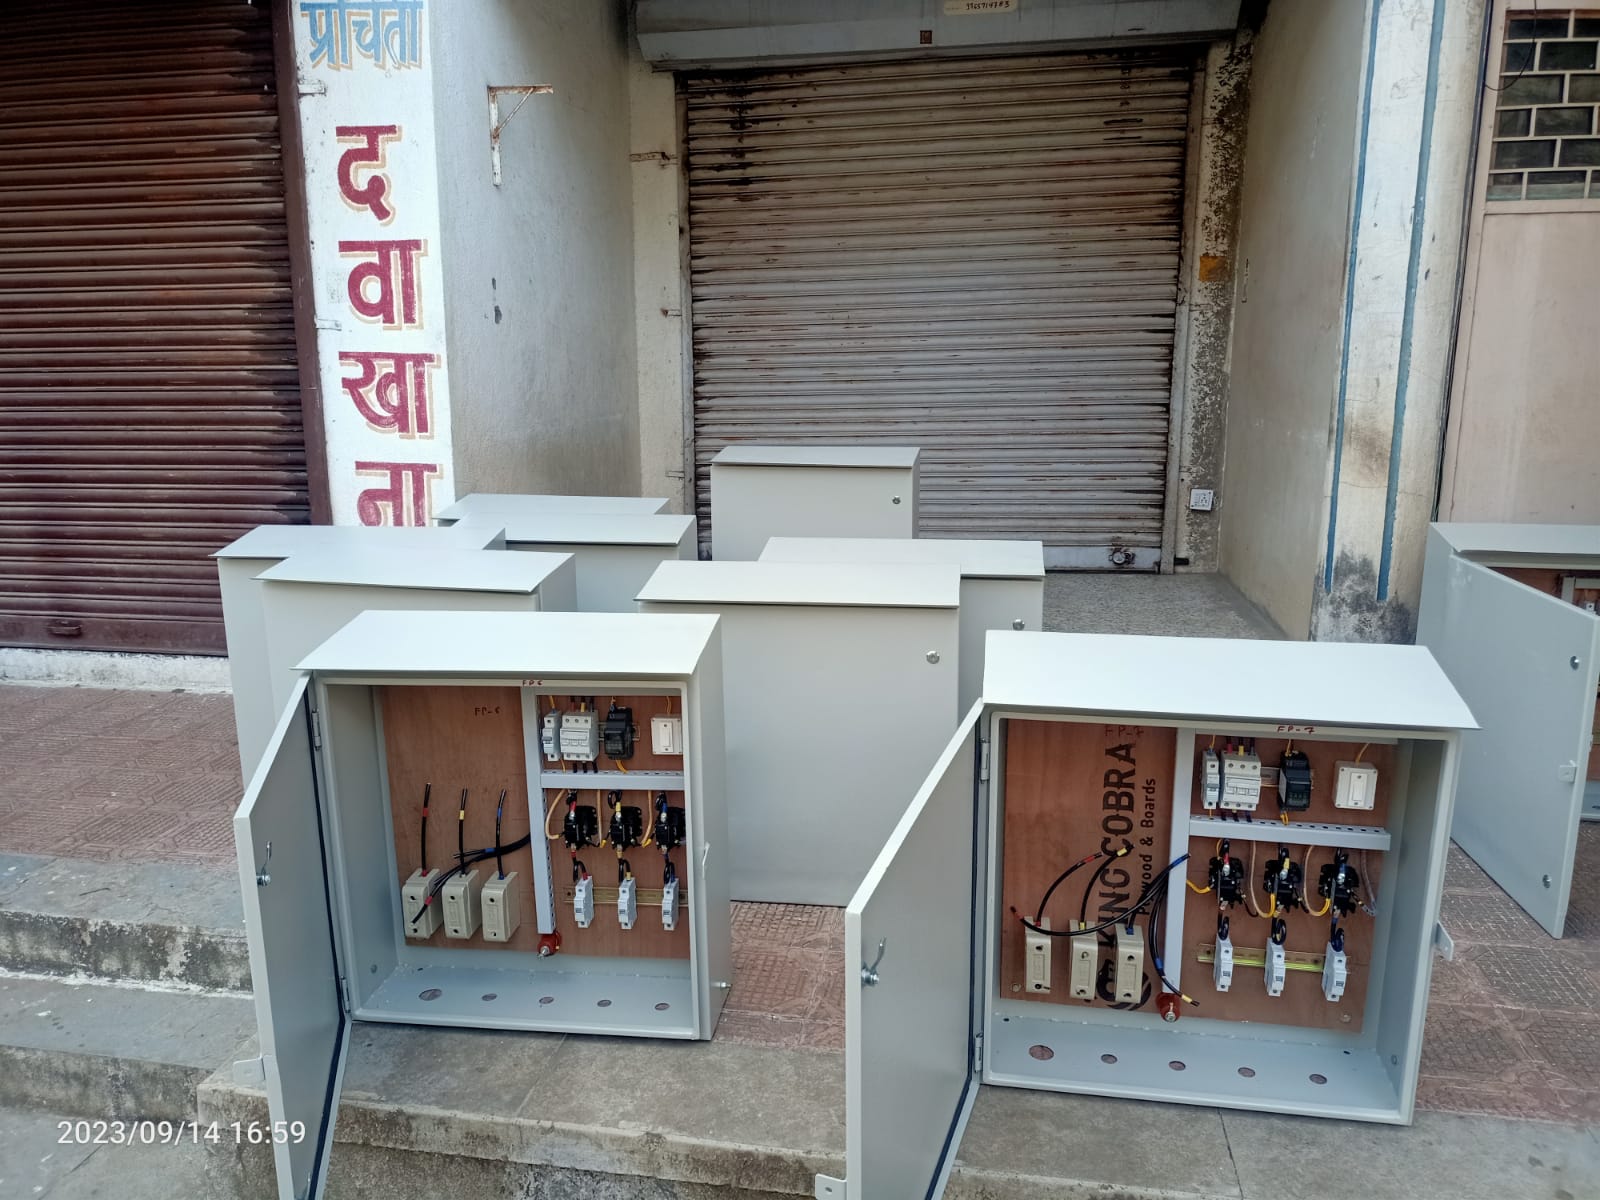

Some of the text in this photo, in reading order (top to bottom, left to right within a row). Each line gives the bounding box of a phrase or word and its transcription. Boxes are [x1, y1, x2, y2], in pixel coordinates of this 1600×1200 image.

[1101, 743, 1136, 857] COBRA
[1137, 778, 1156, 915] Pwood & Boards
